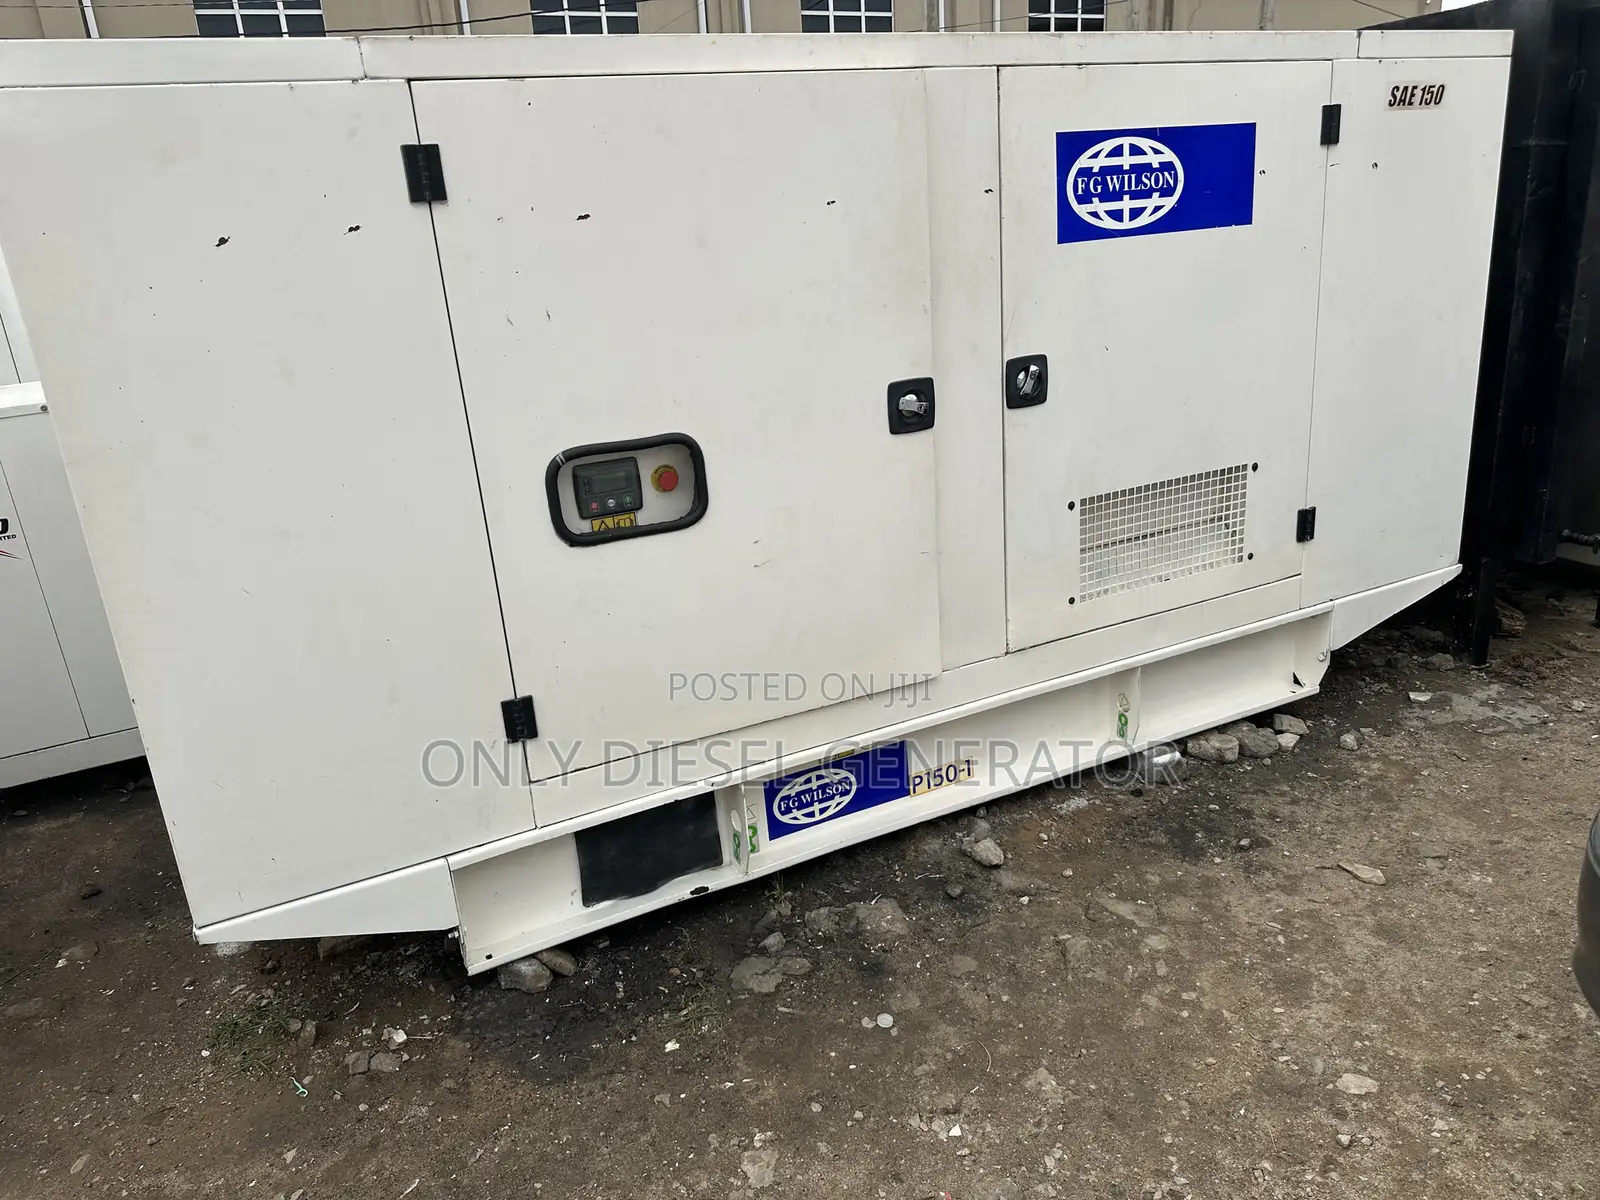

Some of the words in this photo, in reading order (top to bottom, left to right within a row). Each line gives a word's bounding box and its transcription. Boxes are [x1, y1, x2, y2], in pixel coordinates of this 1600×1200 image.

[1388, 85, 1418, 107] SAE
[1418, 84, 1446, 106] 150
[1105, 170, 1176, 193] WILSON
[911, 759, 972, 795] P150-1
[800, 780, 851, 804] WILSON
